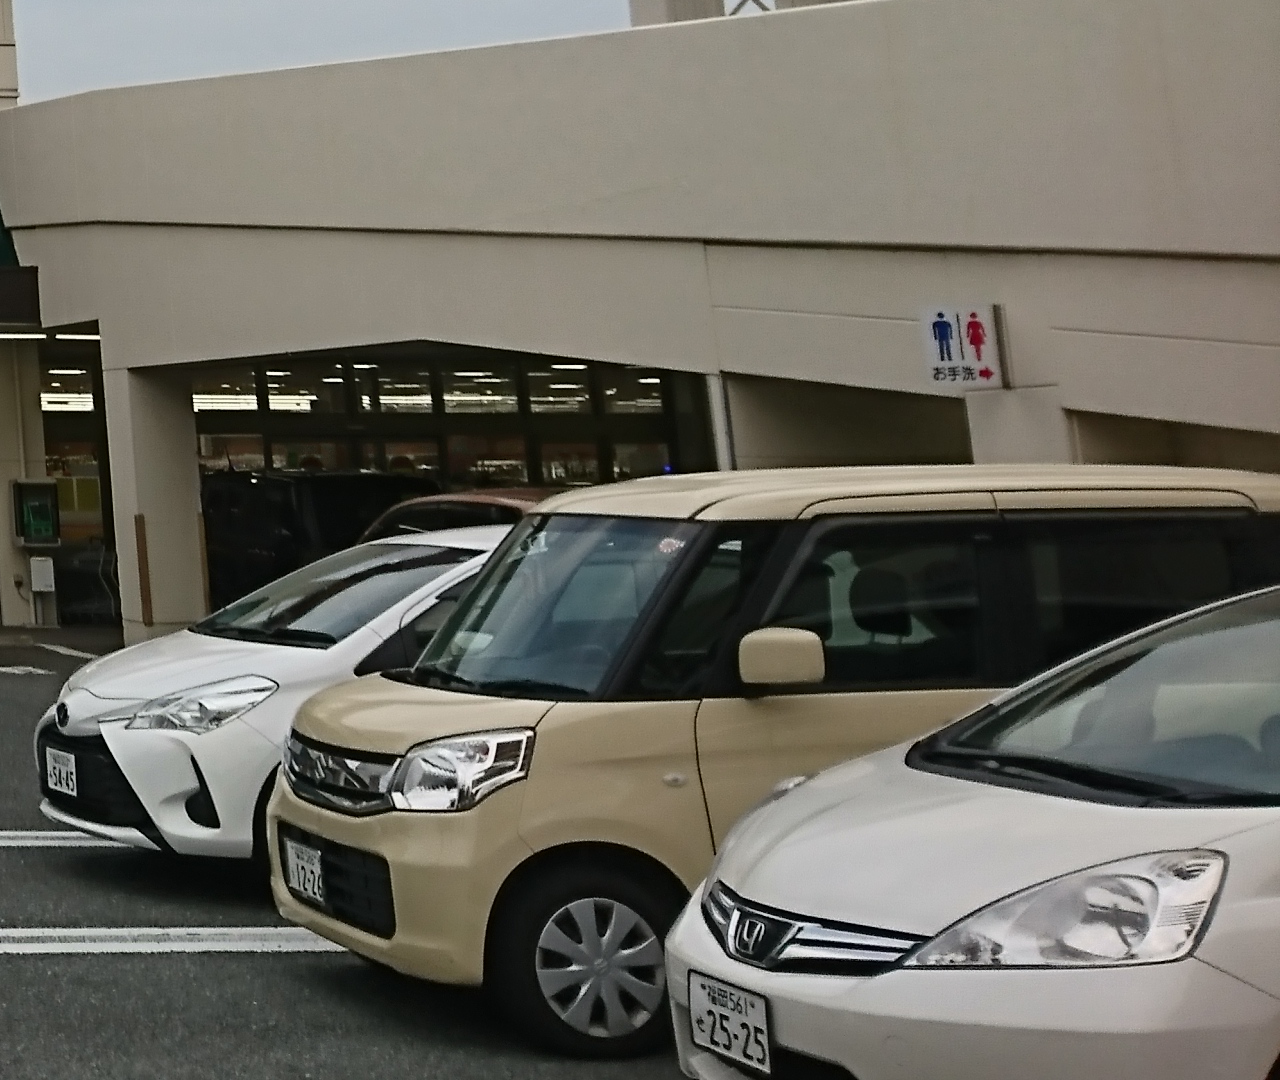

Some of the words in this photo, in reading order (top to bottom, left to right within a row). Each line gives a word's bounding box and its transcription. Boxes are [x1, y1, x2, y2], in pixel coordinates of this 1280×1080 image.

[933, 366, 977, 382] お手洗
[706, 1009, 767, 1066] 25-25
